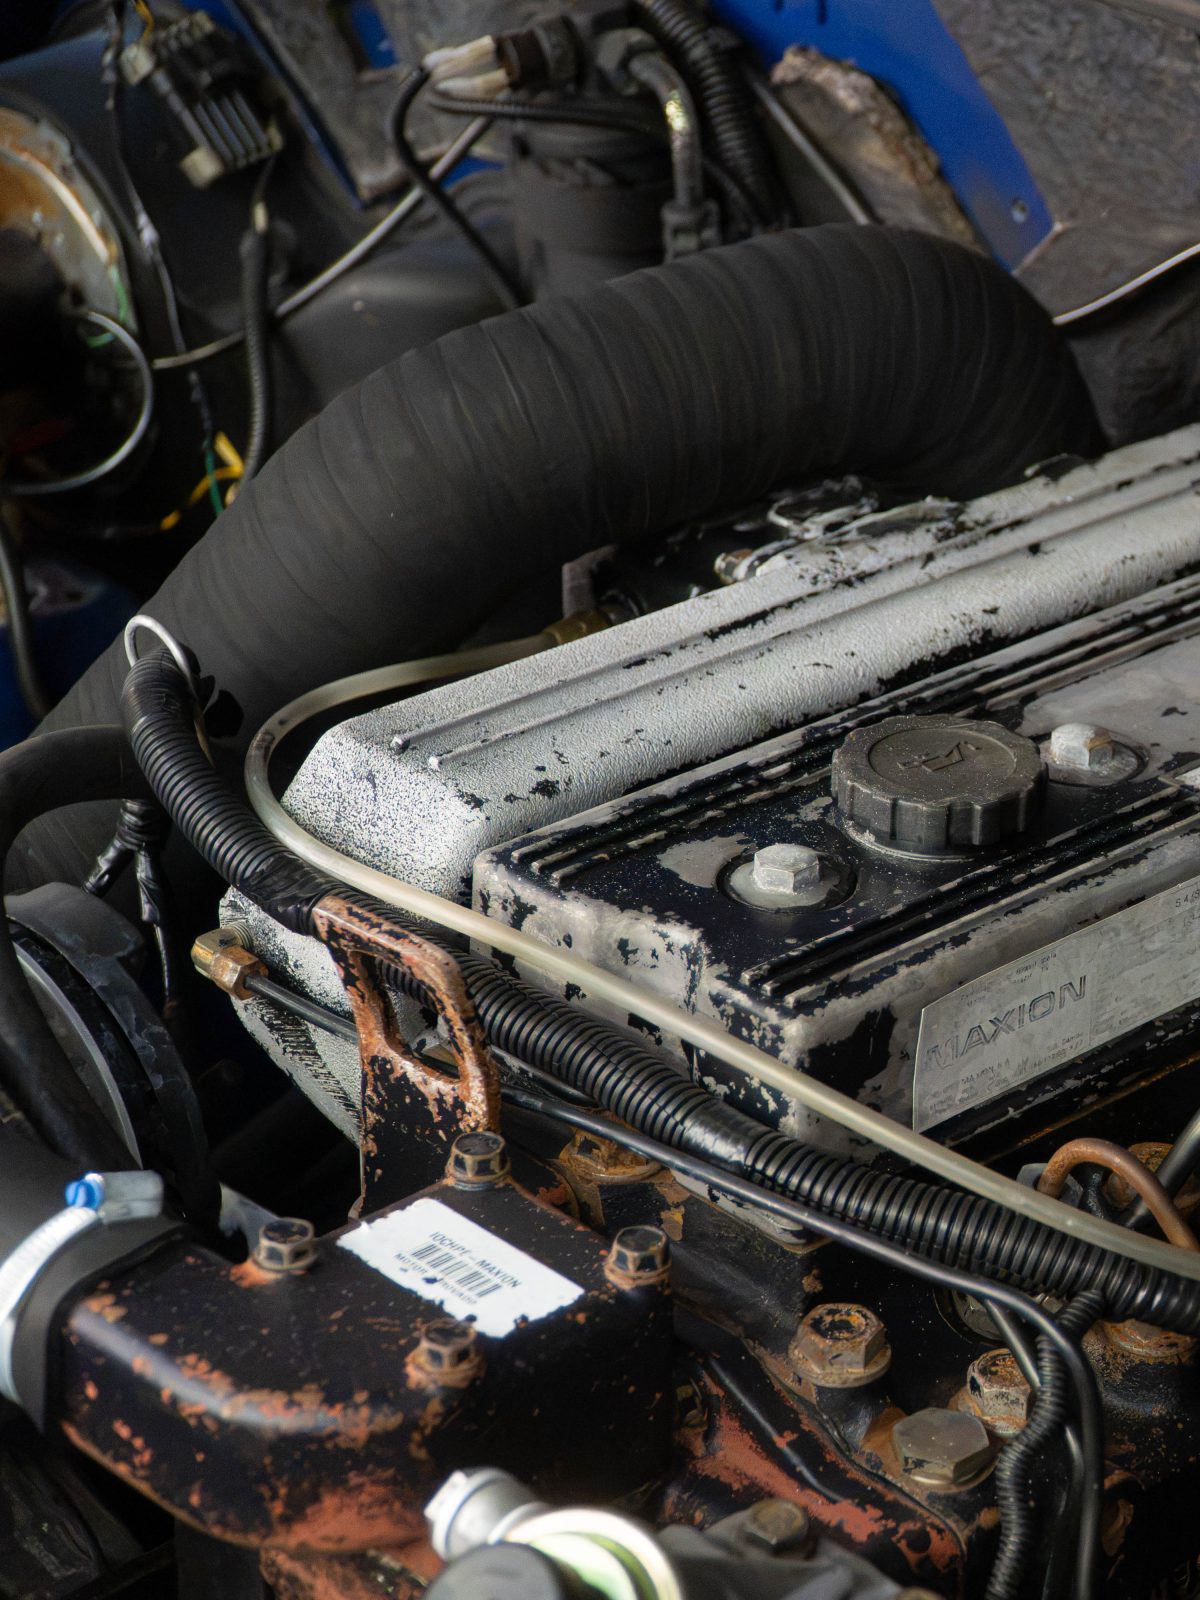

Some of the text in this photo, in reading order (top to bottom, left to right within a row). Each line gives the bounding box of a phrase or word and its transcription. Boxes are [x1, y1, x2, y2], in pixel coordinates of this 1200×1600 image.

[925, 975, 1087, 1070] MAXION
[394, 1252, 428, 1275] MOTOR
[428, 1231, 472, 1257] IOCHPE
[476, 1259, 522, 1289] MAXION
